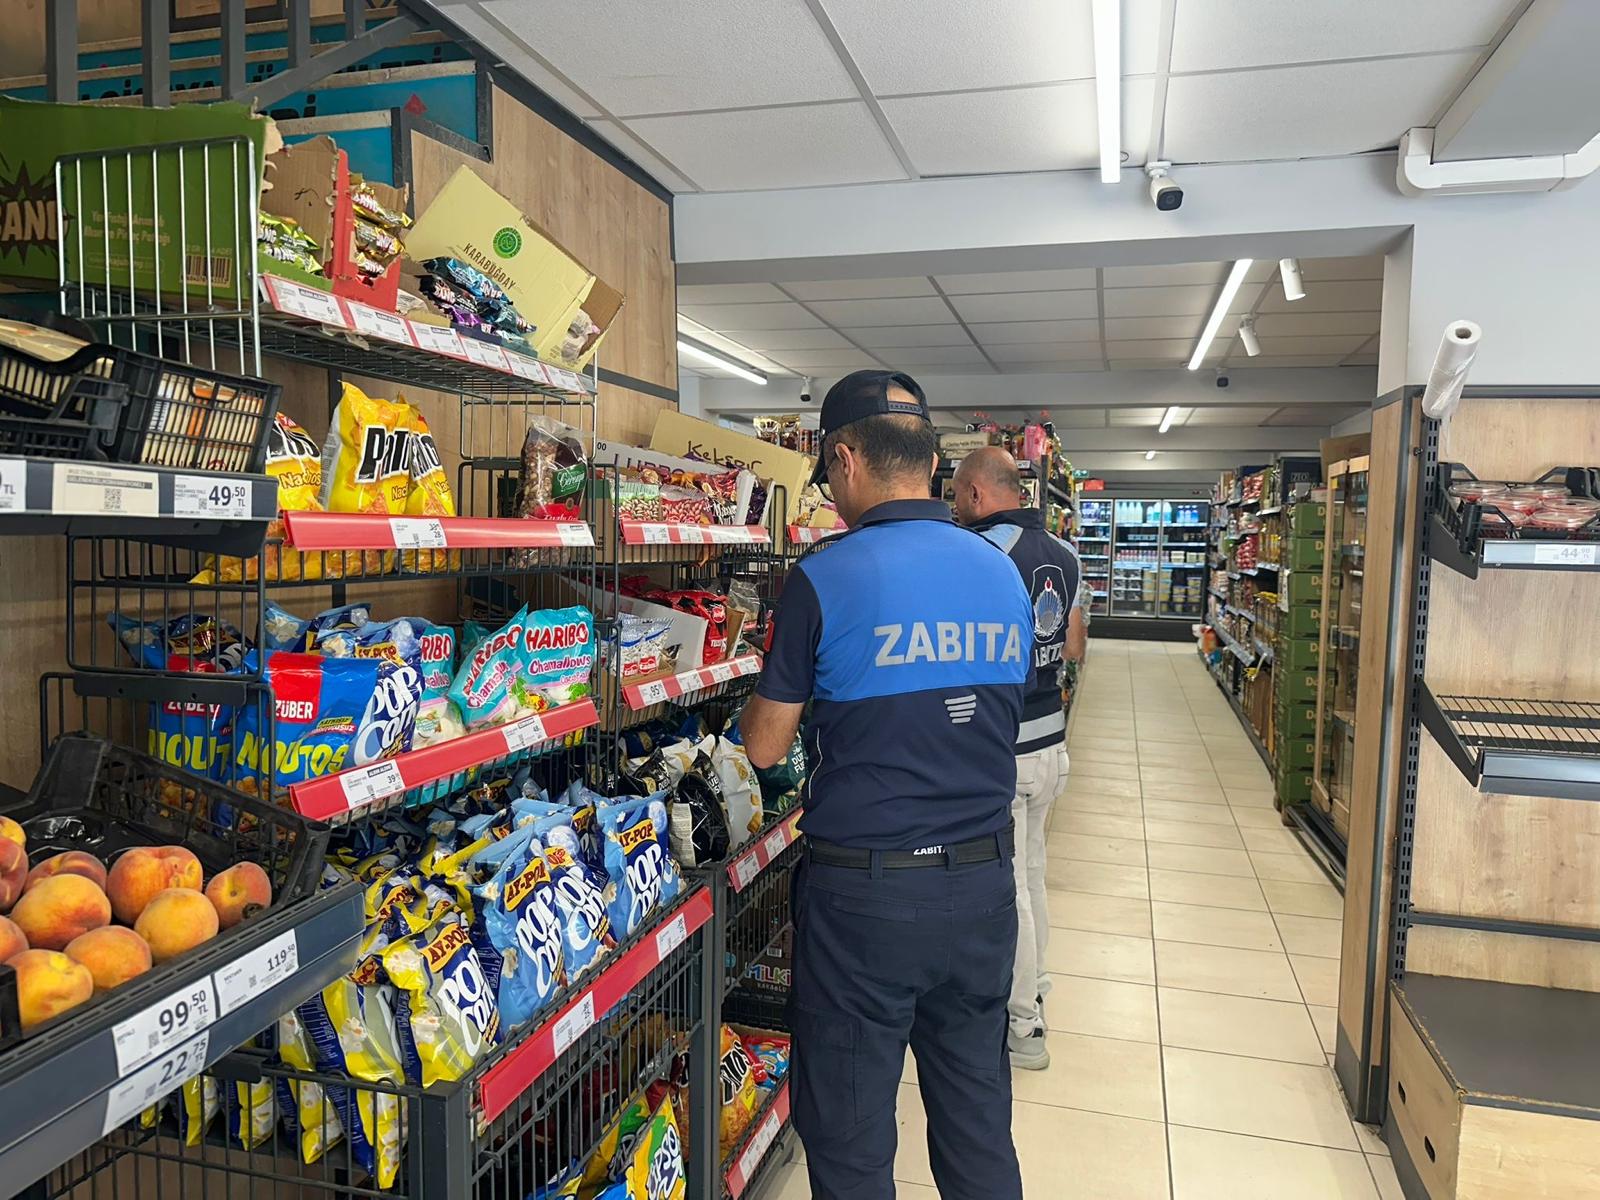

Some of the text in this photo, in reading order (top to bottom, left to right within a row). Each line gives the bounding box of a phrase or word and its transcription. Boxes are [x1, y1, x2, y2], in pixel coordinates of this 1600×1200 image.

[526, 622, 589, 652] HARIBO
[874, 622, 1021, 667] ZABITA
[530, 656, 592, 675] Chamallows
